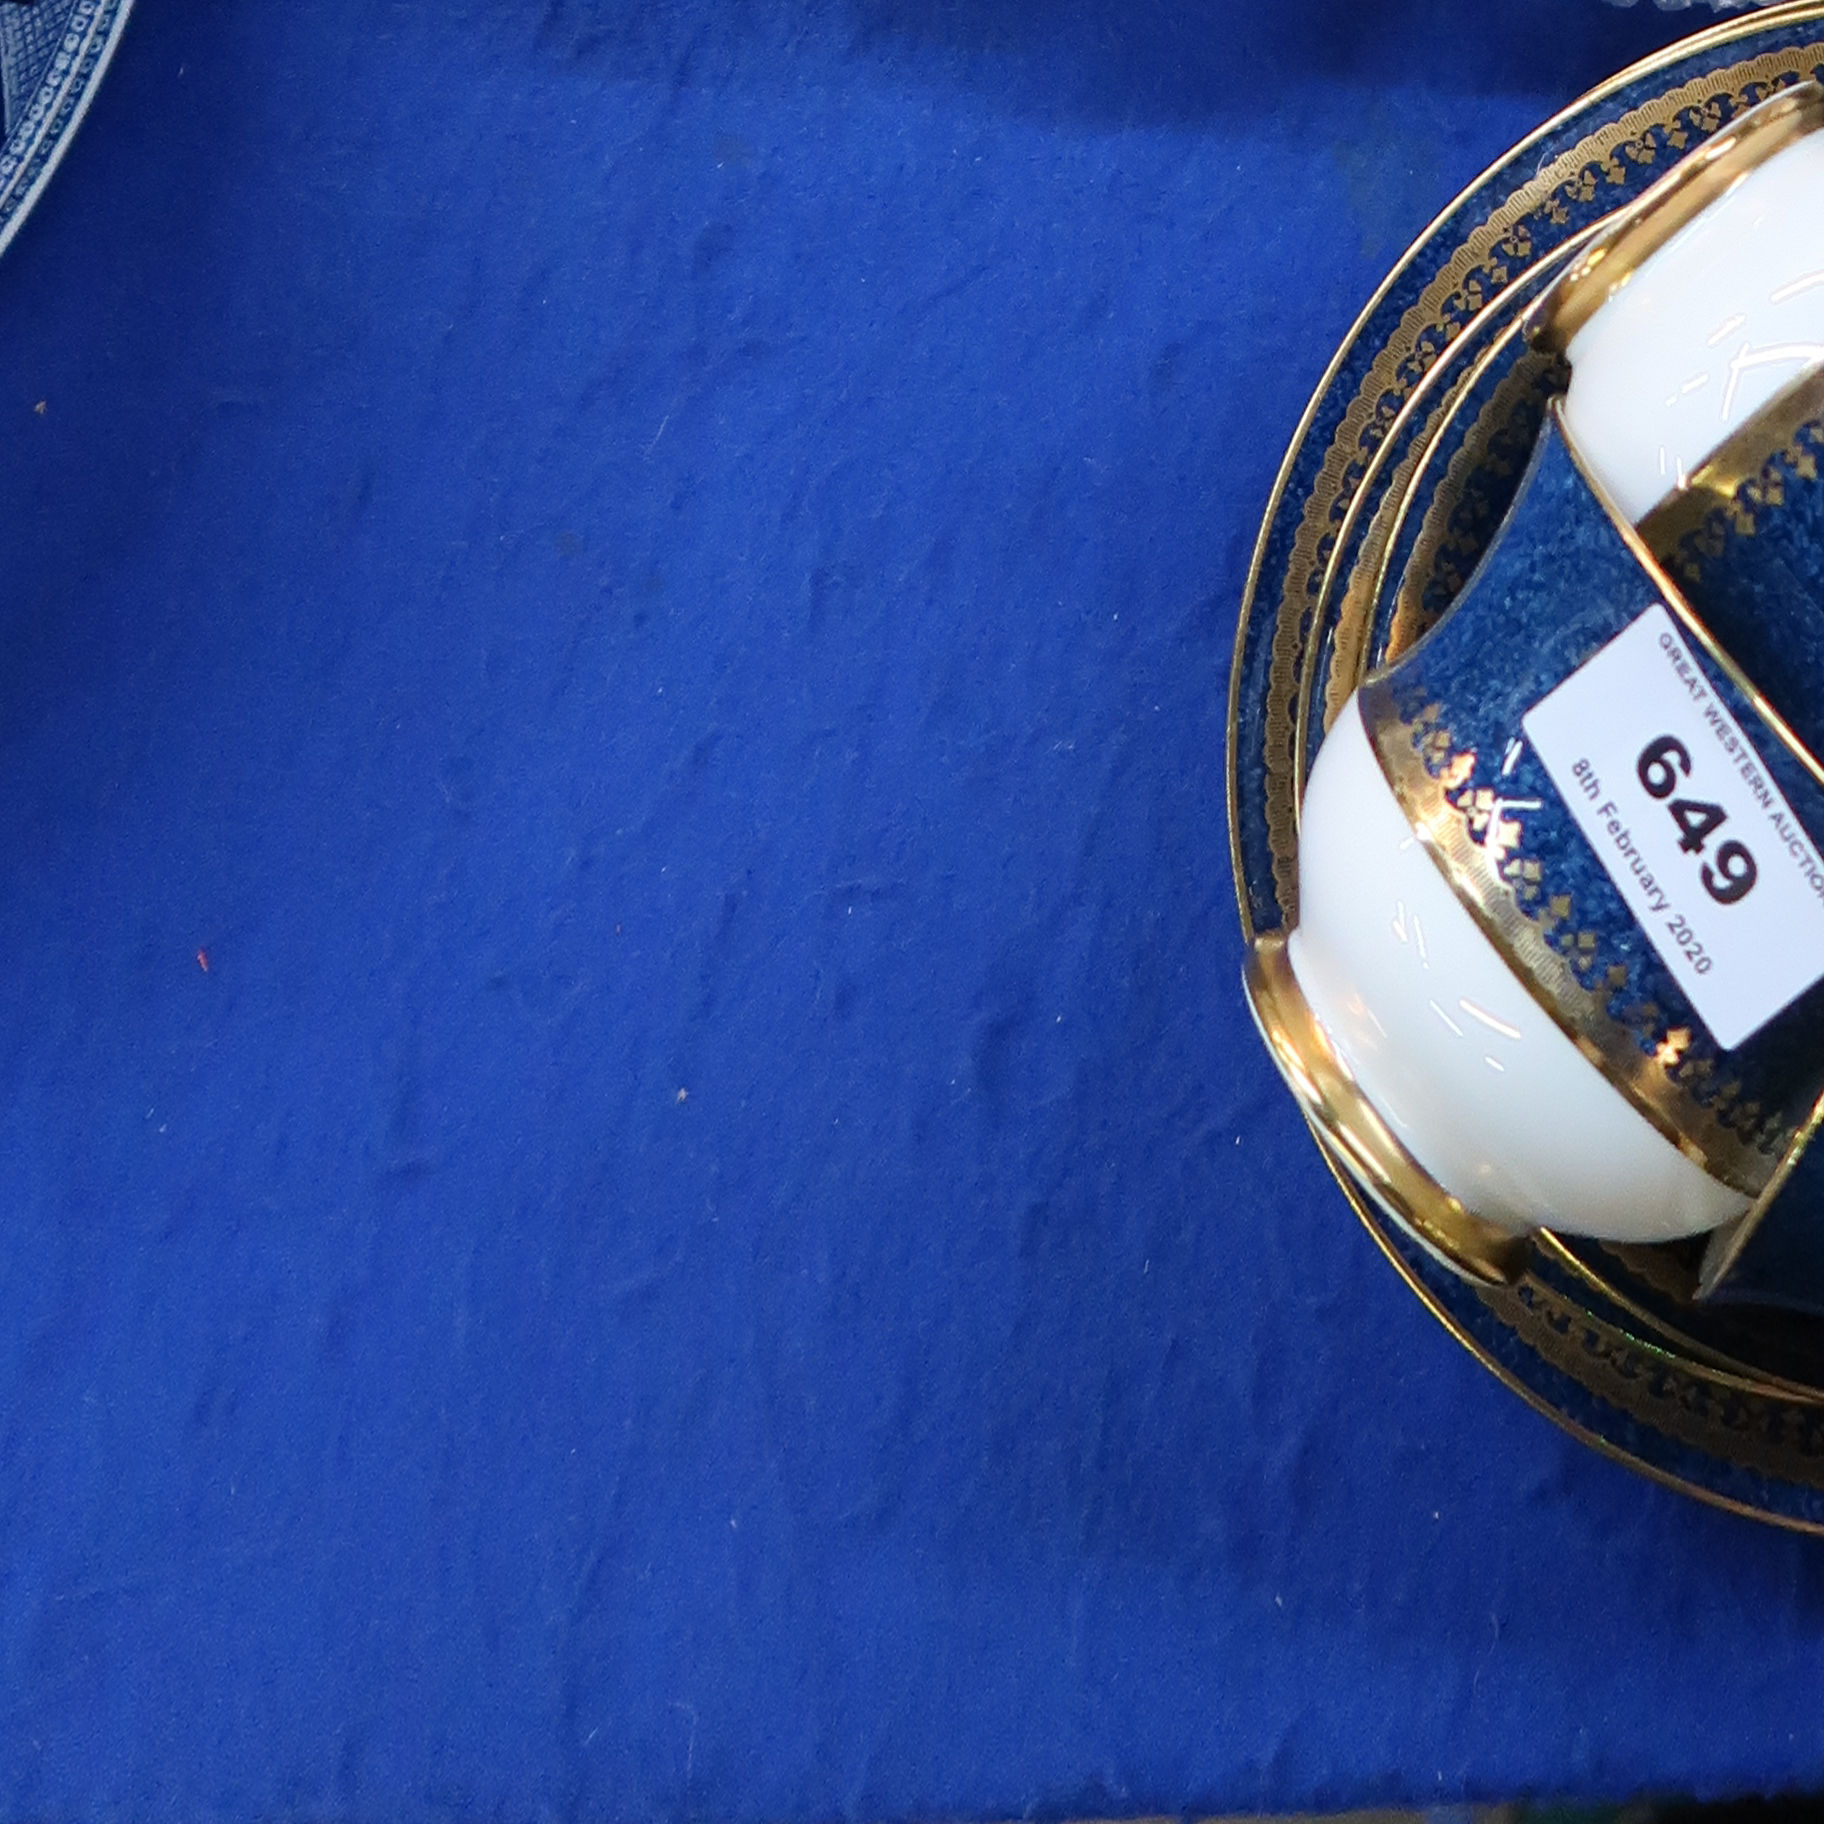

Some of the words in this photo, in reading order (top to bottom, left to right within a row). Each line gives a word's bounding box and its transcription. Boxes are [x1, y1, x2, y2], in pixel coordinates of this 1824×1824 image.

[1658, 632, 1707, 709] GREAT
[1703, 704, 1775, 811] WESTERN
[1572, 758, 1600, 802] 8th
[1597, 803, 1671, 912] February
[1667, 915, 1714, 976] 2020
[1636, 734, 1757, 905] 649
